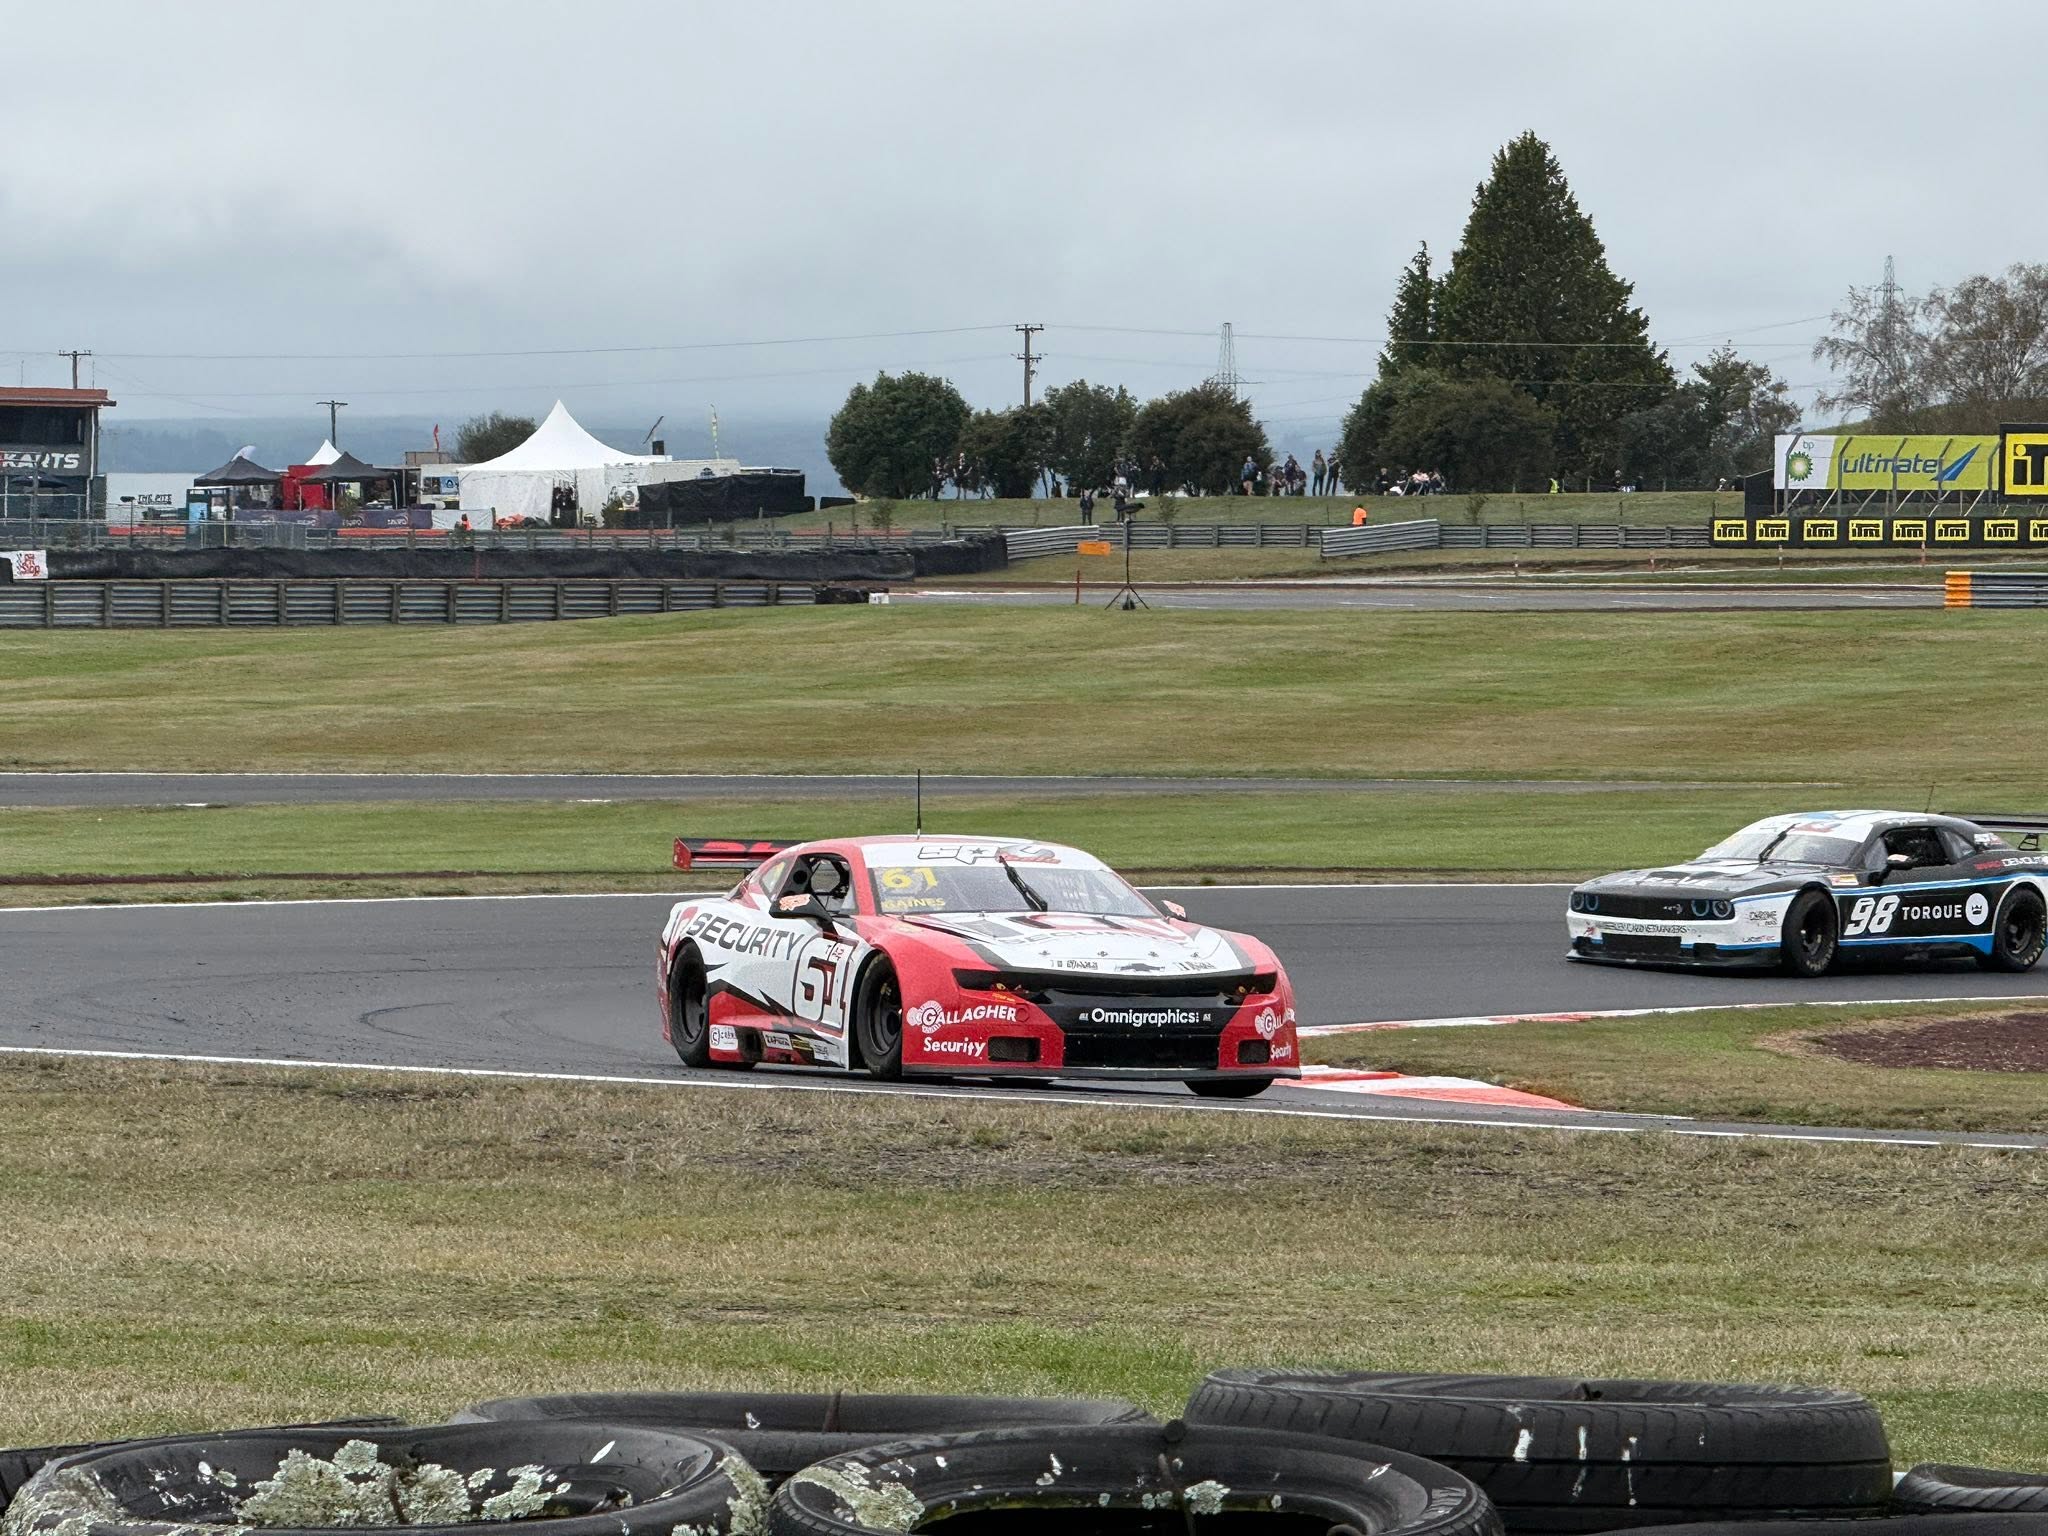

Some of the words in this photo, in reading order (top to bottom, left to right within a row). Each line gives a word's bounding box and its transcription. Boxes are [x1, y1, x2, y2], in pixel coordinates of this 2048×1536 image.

[1803, 441, 1815, 454] bp
[1843, 454, 1938, 473] ultimate
[882, 867, 939, 890] 61
[1844, 895, 1901, 936] 98
[1902, 904, 1963, 921] TORQUE
[686, 912, 805, 961] SECURITY
[794, 936, 858, 1034] 61
[920, 1004, 1017, 1026] GALLAGHER
[1091, 1007, 1196, 1028] Omnigraphics
[923, 1036, 987, 1058] Security
